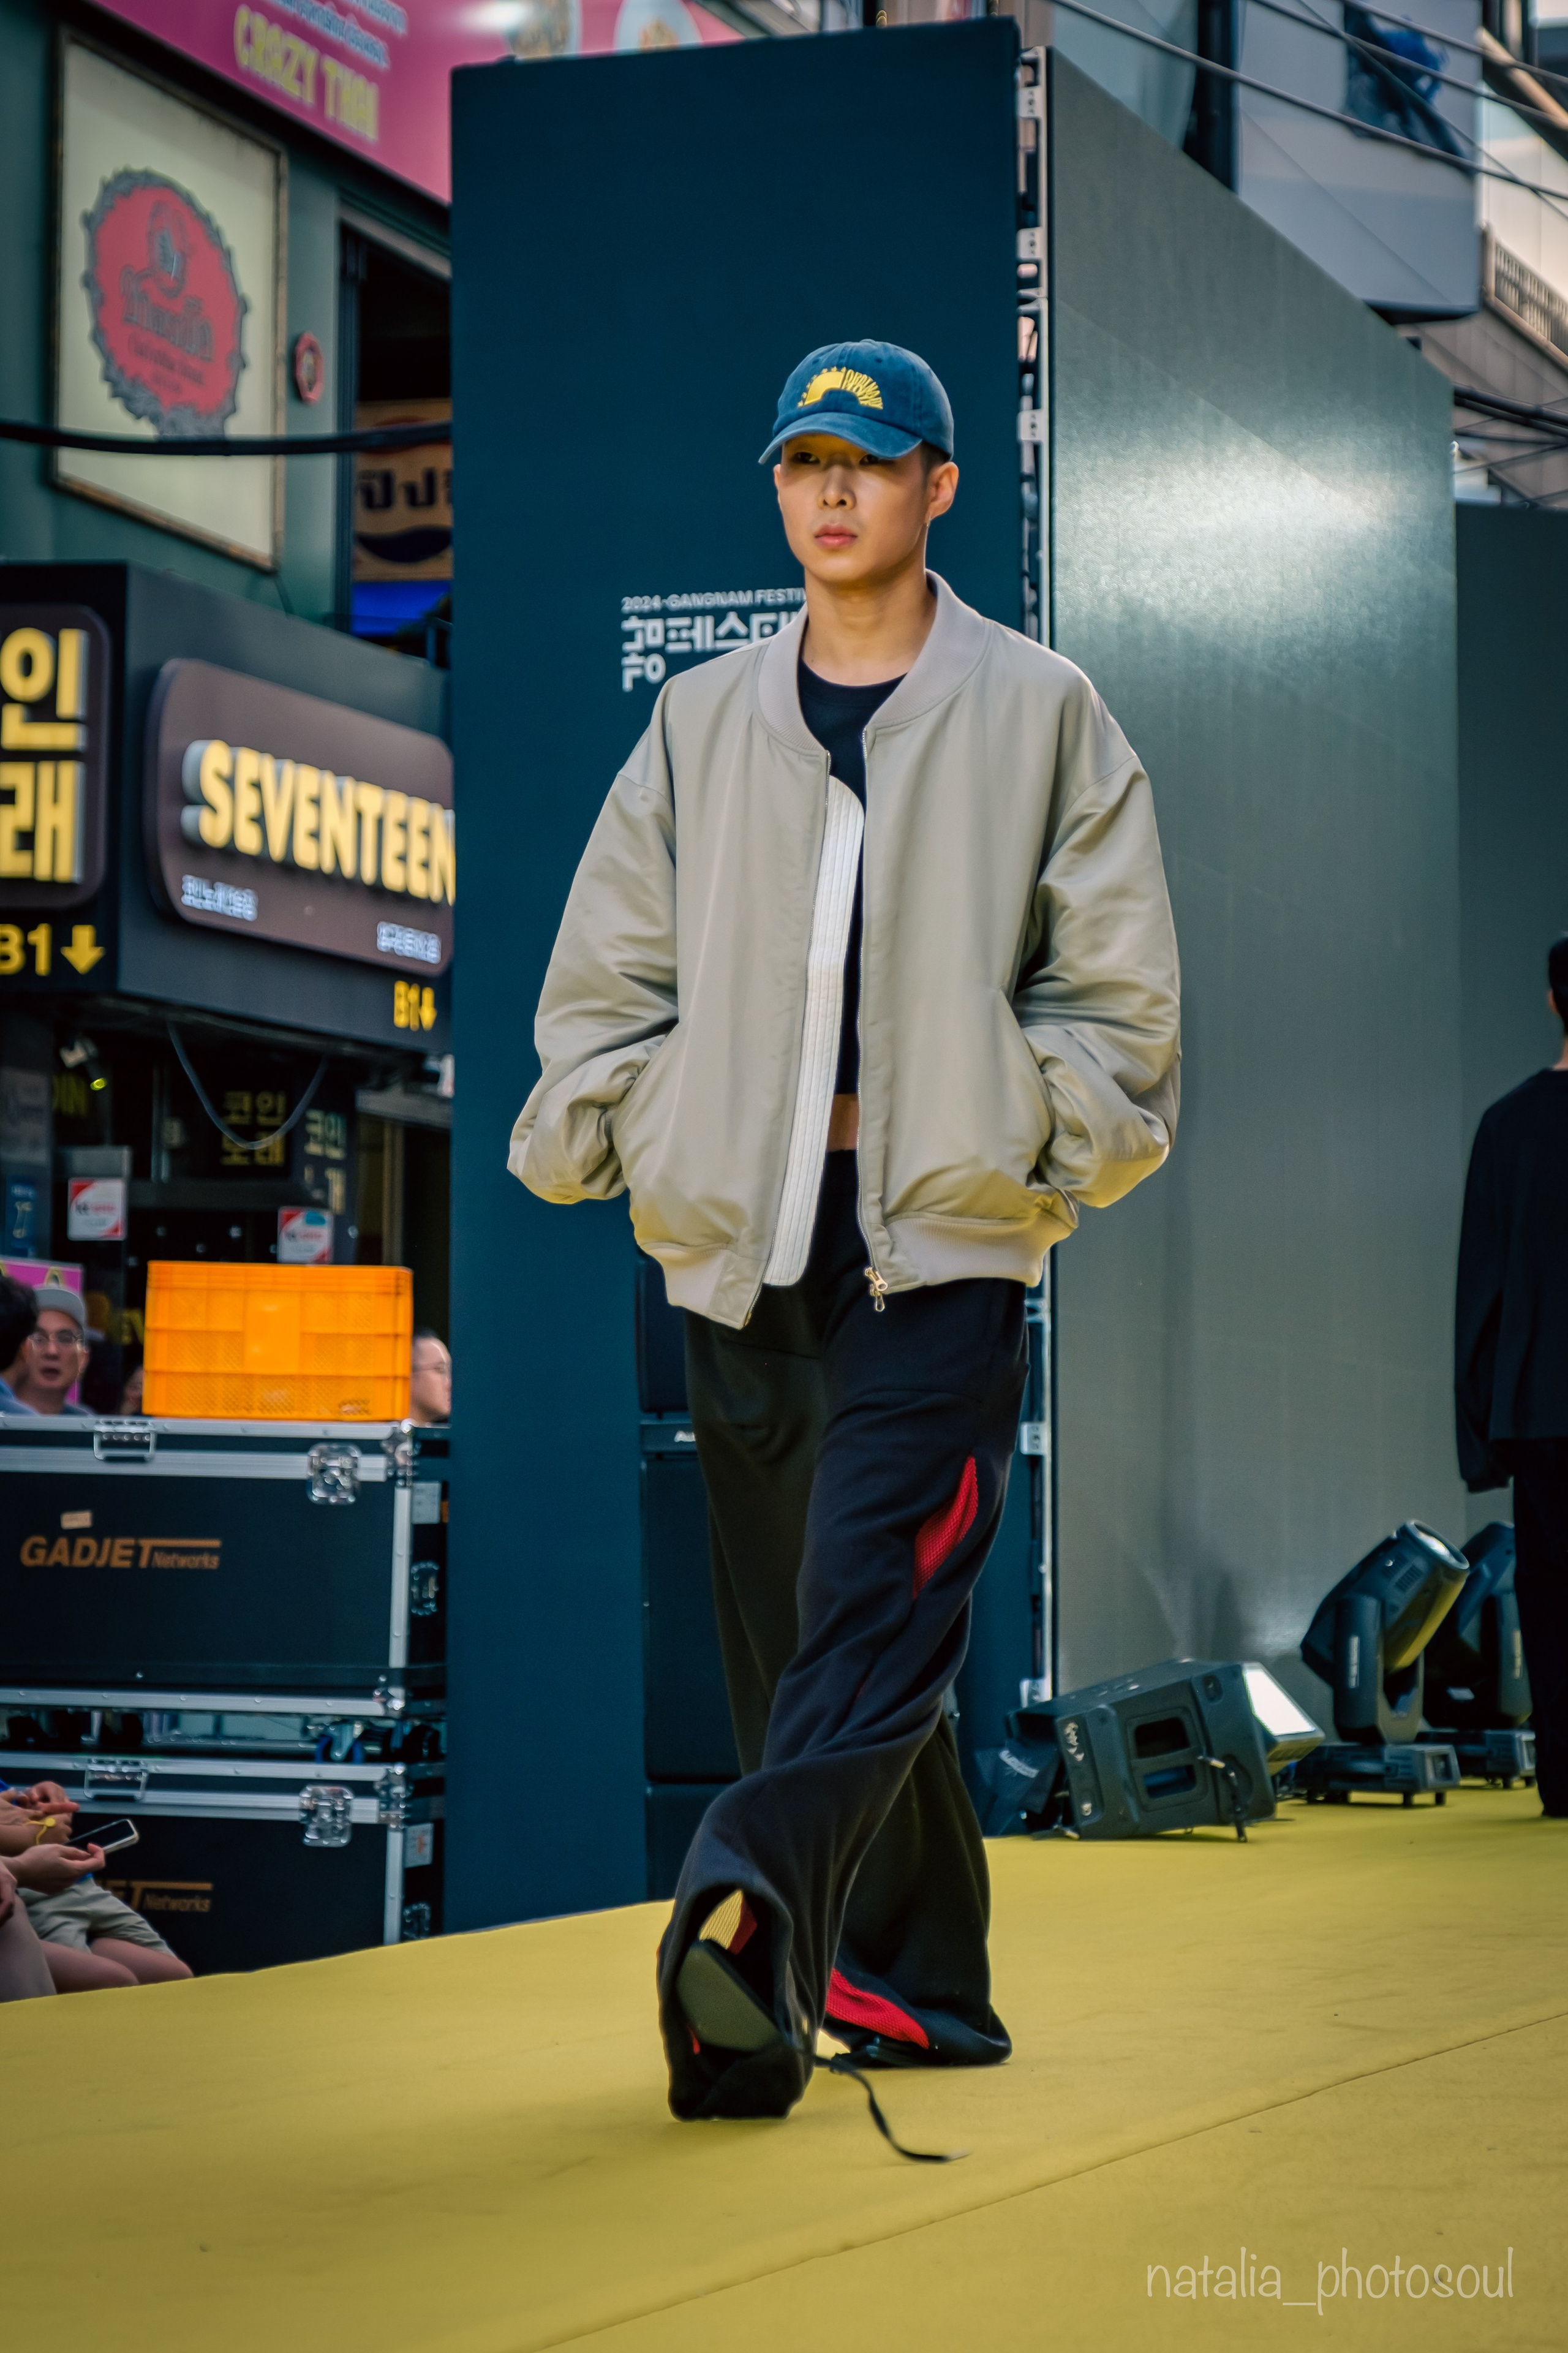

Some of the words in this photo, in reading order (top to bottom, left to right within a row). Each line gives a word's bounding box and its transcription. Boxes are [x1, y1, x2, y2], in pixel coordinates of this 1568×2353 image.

[754, 587, 807, 607] FESTI
[182, 739, 456, 907] SEVENTEEN
[0, 923, 53, 976] B1
[394, 980, 421, 1031] B1
[20, 1535, 221, 1569] GADJET
